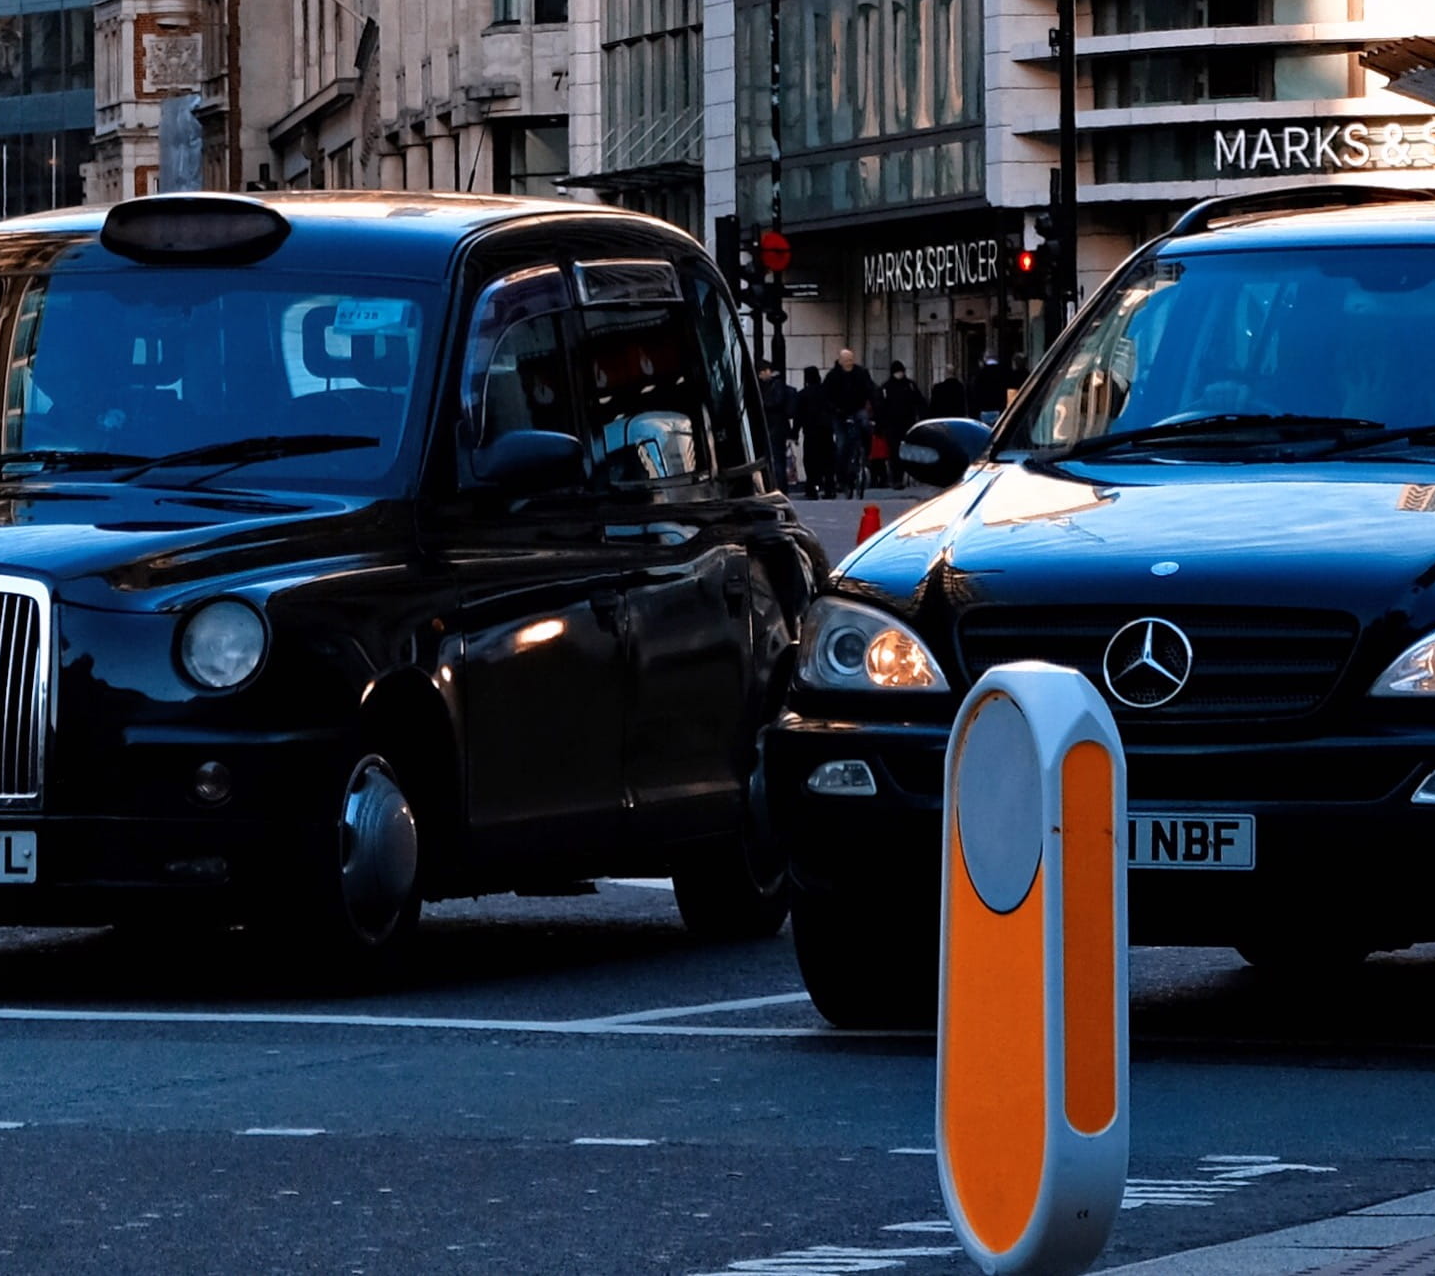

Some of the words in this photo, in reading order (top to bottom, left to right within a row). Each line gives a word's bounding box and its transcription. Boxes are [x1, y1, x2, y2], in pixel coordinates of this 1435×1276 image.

[1214, 122, 1371, 171] MARKS
[1381, 122, 1413, 167] &
[864, 249, 913, 295] MARKS
[926, 239, 999, 293] SPENCER
[1151, 820, 1240, 863] NBF
